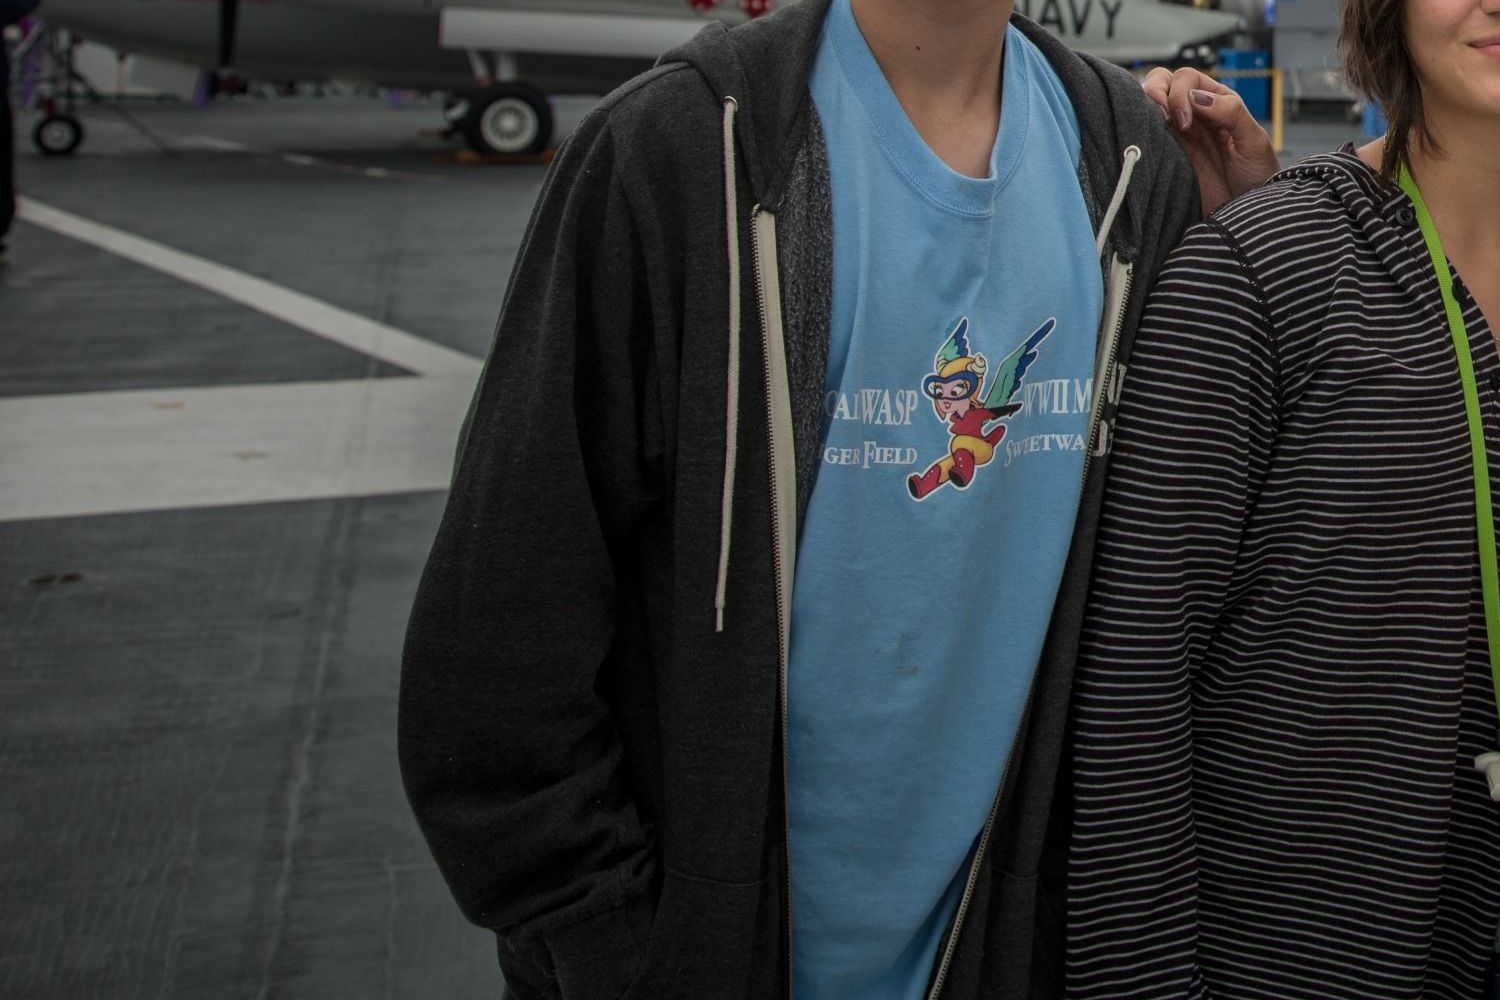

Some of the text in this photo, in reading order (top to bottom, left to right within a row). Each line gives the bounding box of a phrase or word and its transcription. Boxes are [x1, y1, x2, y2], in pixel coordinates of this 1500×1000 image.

[861, 388, 919, 425] WASP
[1024, 378, 1070, 417] WWII
[820, 444, 860, 465] GER
[861, 440, 918, 469] FIELD
